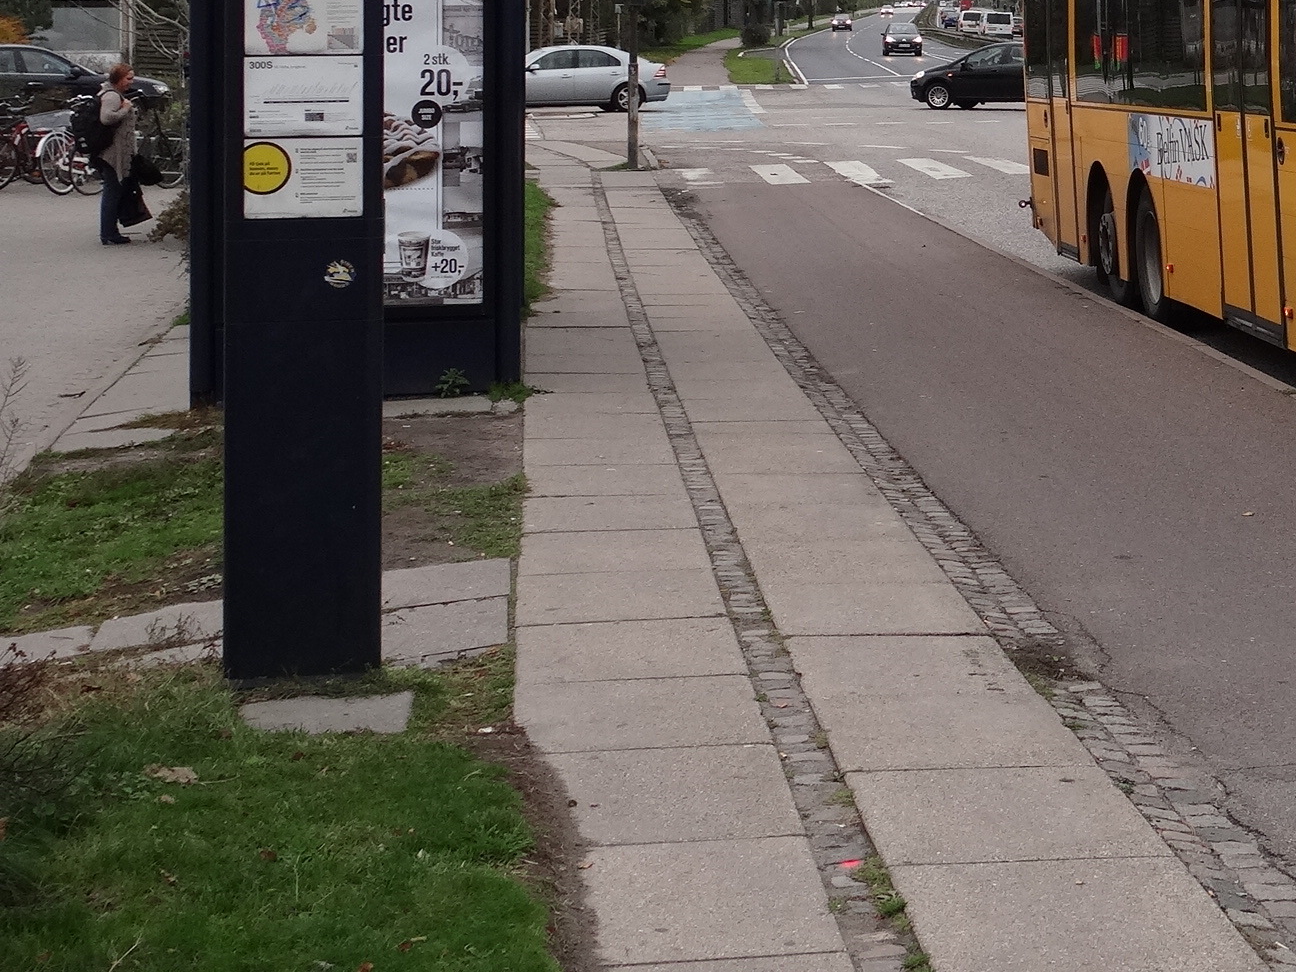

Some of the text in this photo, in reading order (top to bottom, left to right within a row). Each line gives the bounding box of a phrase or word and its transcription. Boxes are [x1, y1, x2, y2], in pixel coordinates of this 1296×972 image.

[385, 35, 408, 54] er
[249, 60, 273, 70] 300S
[423, 52, 451, 65] 2 stk.
[420, 68, 463, 102] 20,-
[431, 258, 465, 276] +20,-
